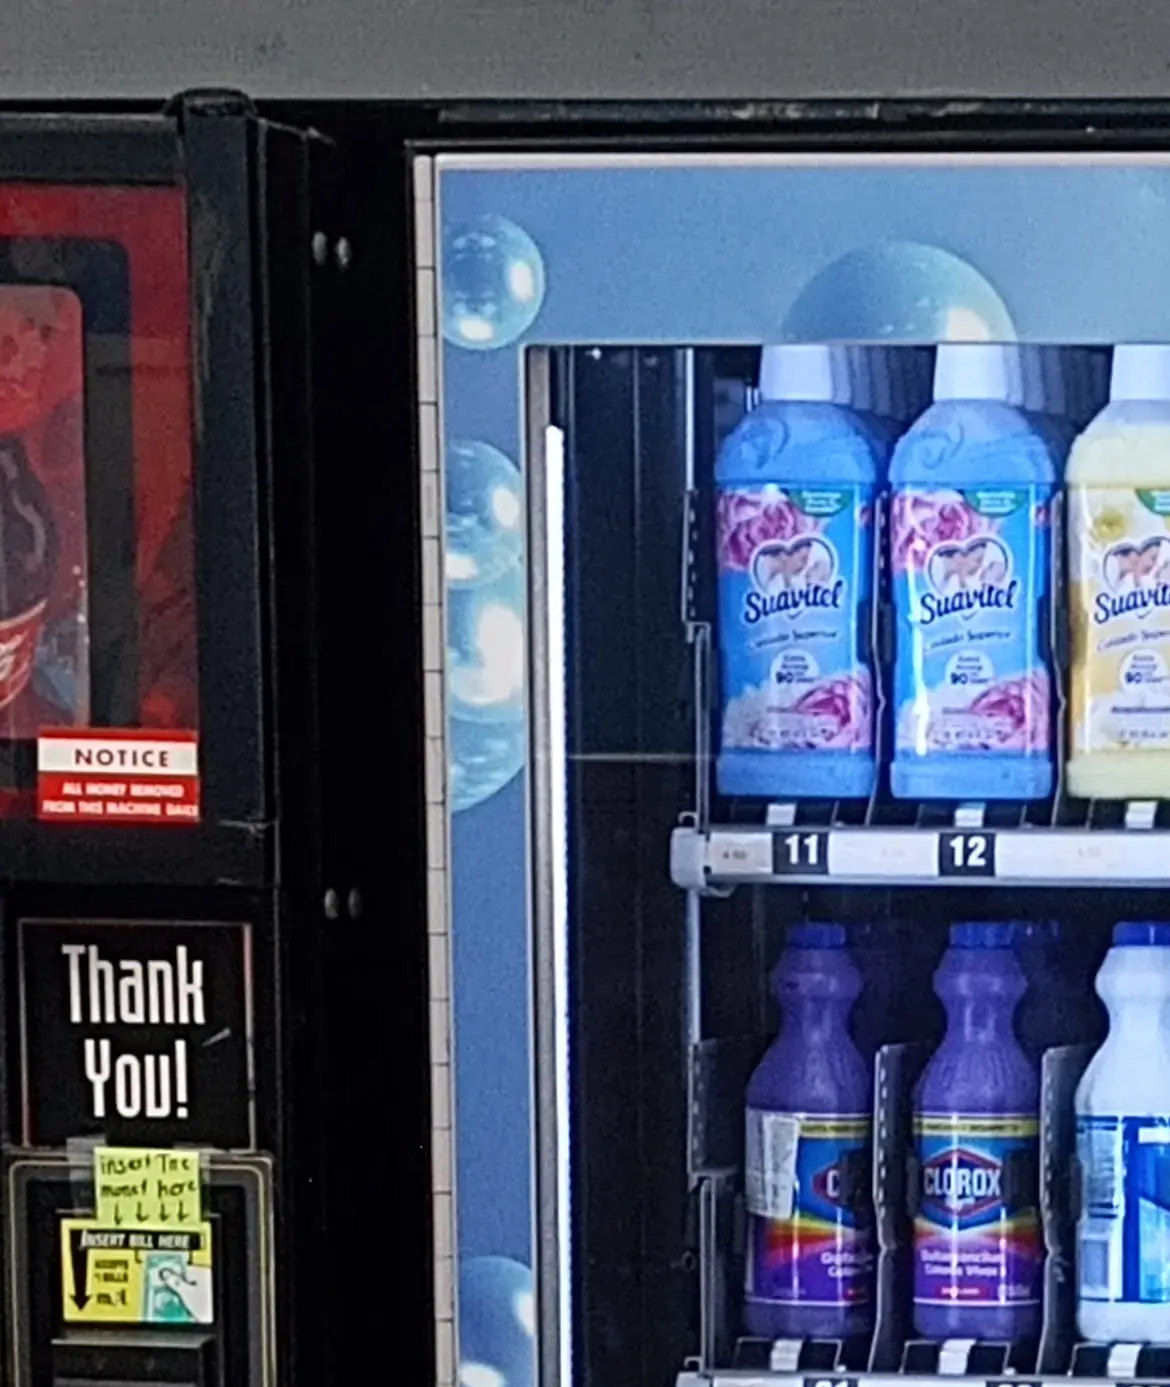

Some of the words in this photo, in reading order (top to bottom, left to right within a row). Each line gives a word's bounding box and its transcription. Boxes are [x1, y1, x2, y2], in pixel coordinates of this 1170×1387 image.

[744, 579, 843, 624] Suavitel
[920, 579, 1017, 625] Suavitel
[75, 748, 170, 768] NOTICE
[784, 836, 818, 865] 11
[950, 836, 986, 867] 12
[61, 944, 206, 1026] Thank
[85, 1038, 189, 1120] You!
[924, 1167, 1002, 1196] CLOROX
[80, 1231, 126, 1250] INSERT
[129, 1233, 154, 1249] BILL
[157, 1234, 190, 1250] HERE
